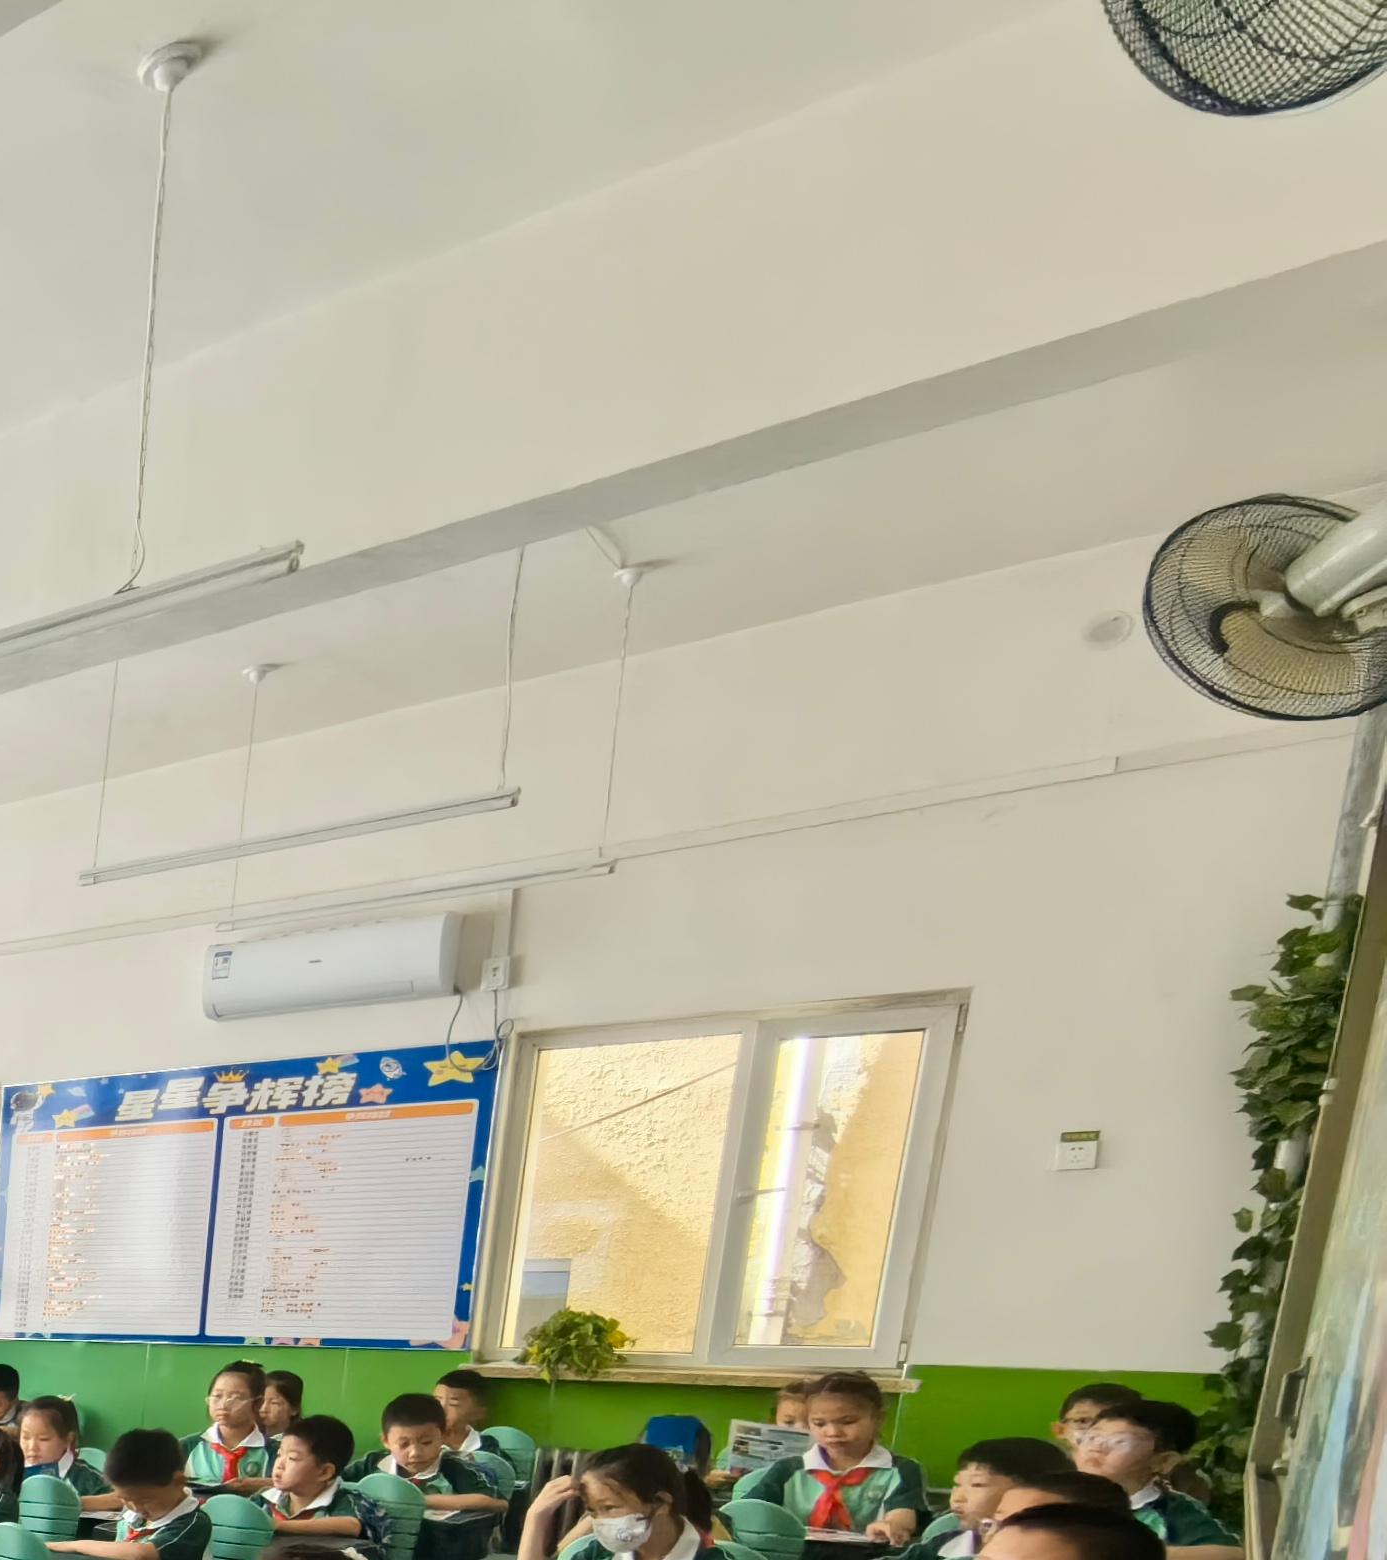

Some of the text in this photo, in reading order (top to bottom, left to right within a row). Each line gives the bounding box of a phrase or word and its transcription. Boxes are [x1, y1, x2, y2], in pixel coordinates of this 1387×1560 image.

[115, 1072, 358, 1122] 星星争辉榜
